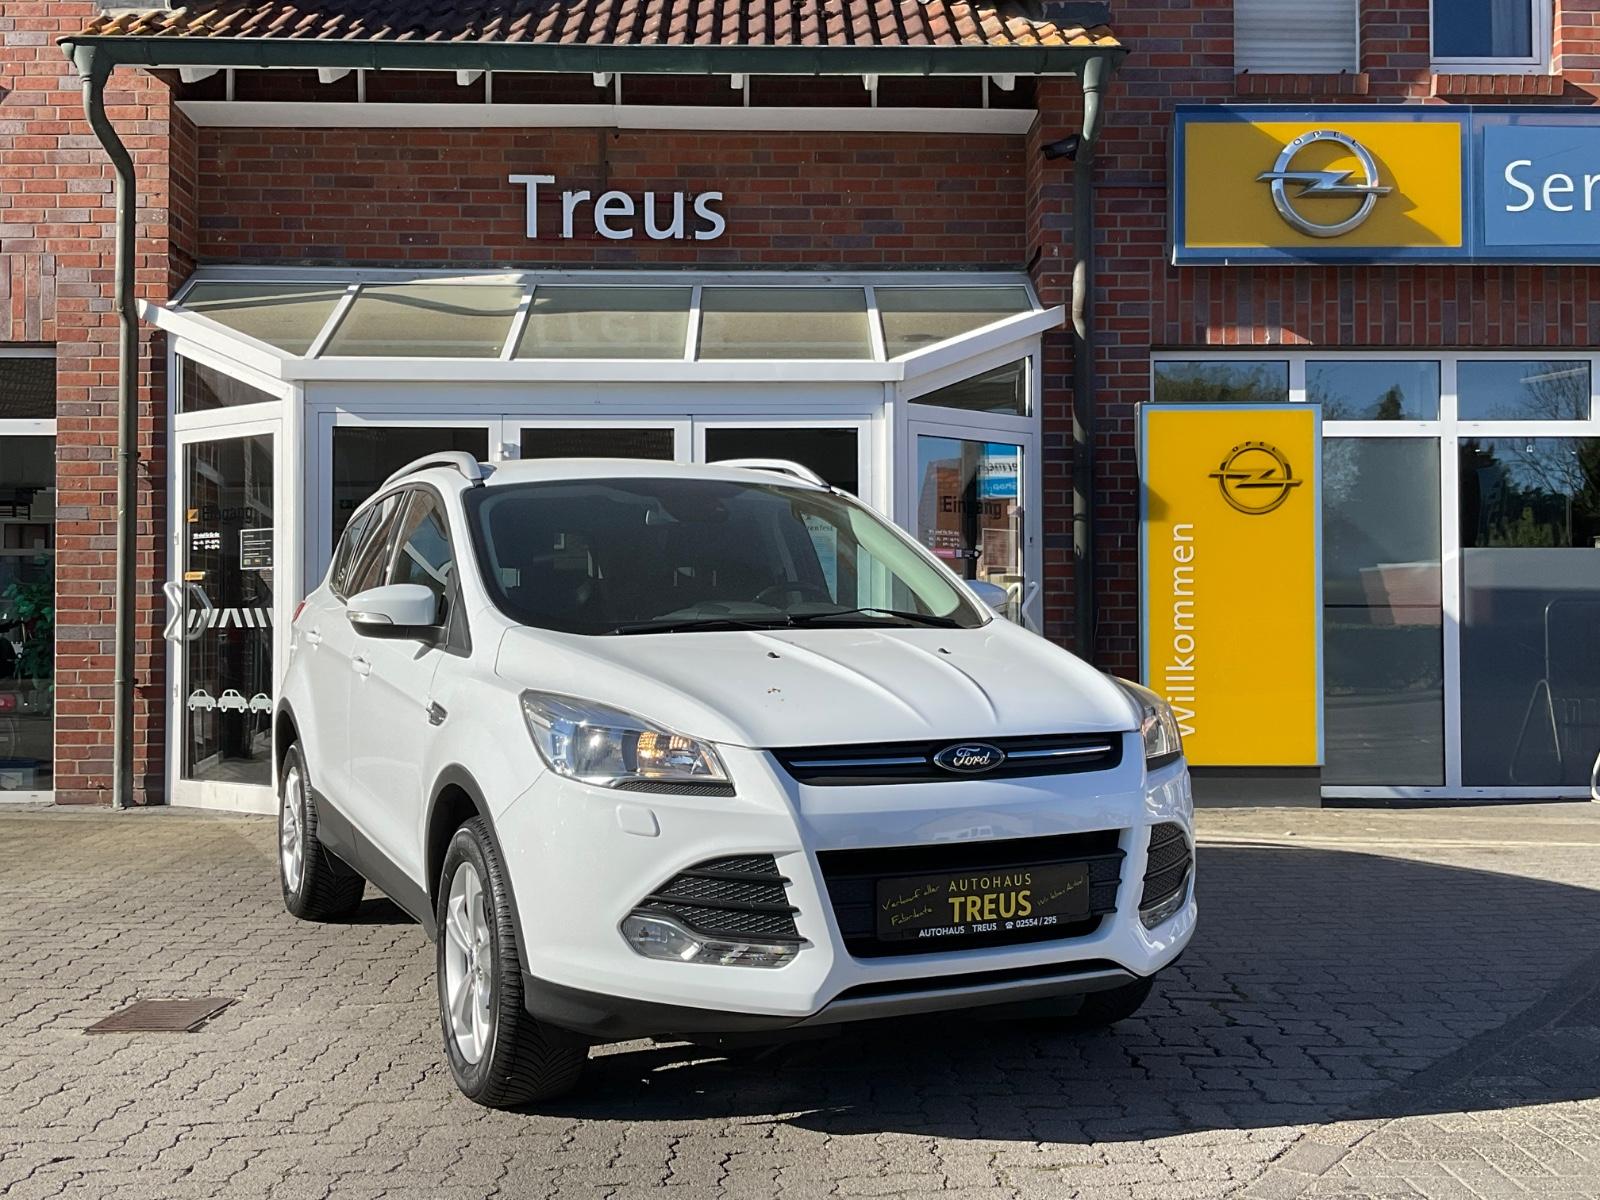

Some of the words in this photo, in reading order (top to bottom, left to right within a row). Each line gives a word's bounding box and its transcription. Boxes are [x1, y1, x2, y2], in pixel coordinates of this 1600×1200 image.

[508, 174, 726, 240] Treus
[1231, 440, 1277, 453] OPEL
[943, 495, 1002, 520] Einang
[1165, 523, 1195, 738] Willkommen
[953, 747, 990, 767] Ford
[948, 873, 1032, 892] AUTOHAUS
[948, 890, 1032, 923] TREUS
[918, 926, 965, 938] AUTOHAUS
[972, 923, 997, 933] TREUS
[1016, 919, 1038, 928] 02554
[1044, 915, 1057, 925] 295
